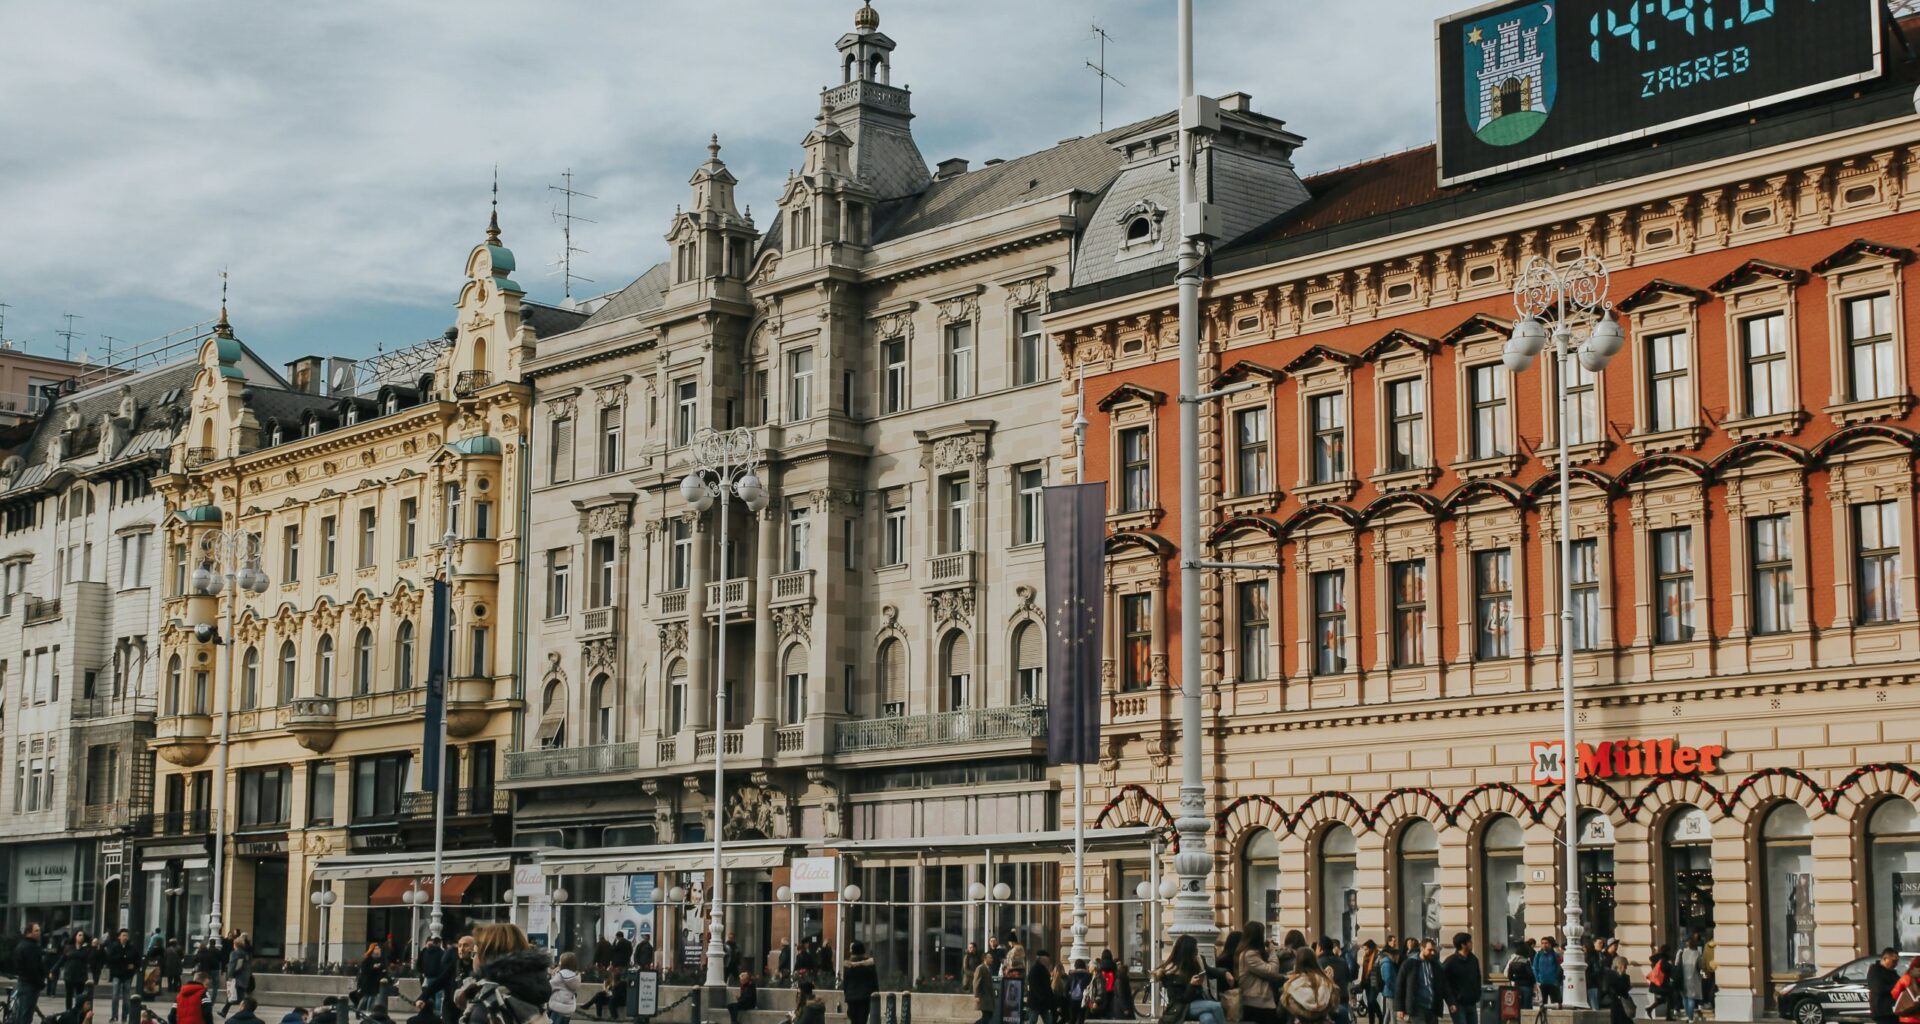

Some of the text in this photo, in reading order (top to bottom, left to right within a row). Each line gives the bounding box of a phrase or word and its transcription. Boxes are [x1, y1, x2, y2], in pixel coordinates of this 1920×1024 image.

[1641, 46, 1750, 97] ZAGREB
[1539, 738, 1724, 779] M Müller
[1828, 992, 1861, 1003] KLEMM
